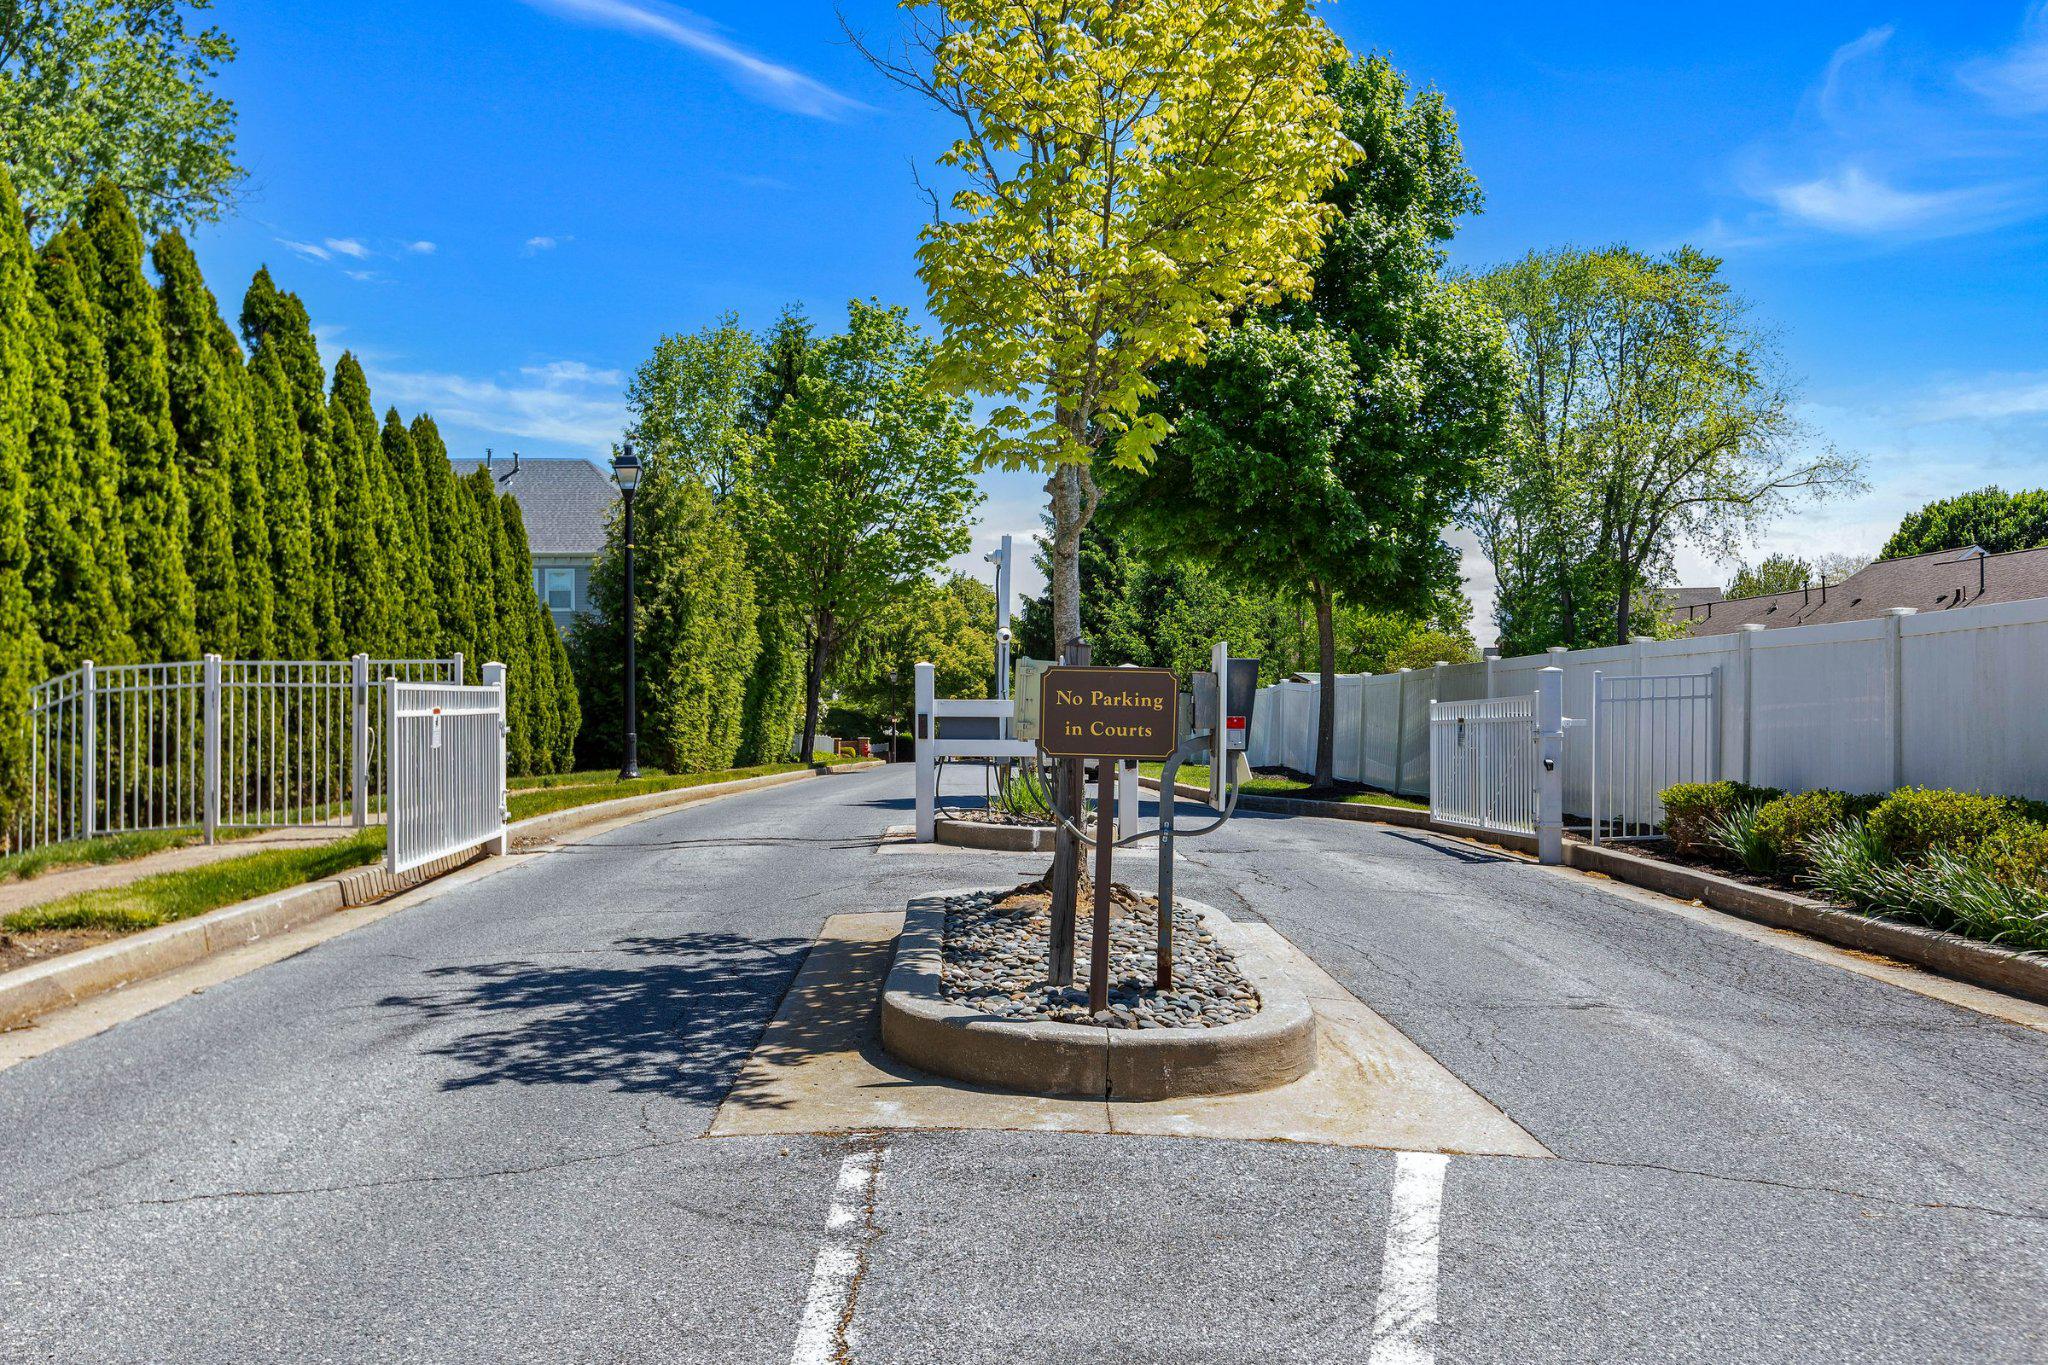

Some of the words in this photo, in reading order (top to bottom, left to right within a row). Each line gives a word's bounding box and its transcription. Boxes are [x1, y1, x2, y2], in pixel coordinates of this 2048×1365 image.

[1056, 690, 1083, 706] No
[1090, 690, 1164, 711] Parking
[1064, 721, 1083, 736] in
[1090, 721, 1152, 737] Courts
